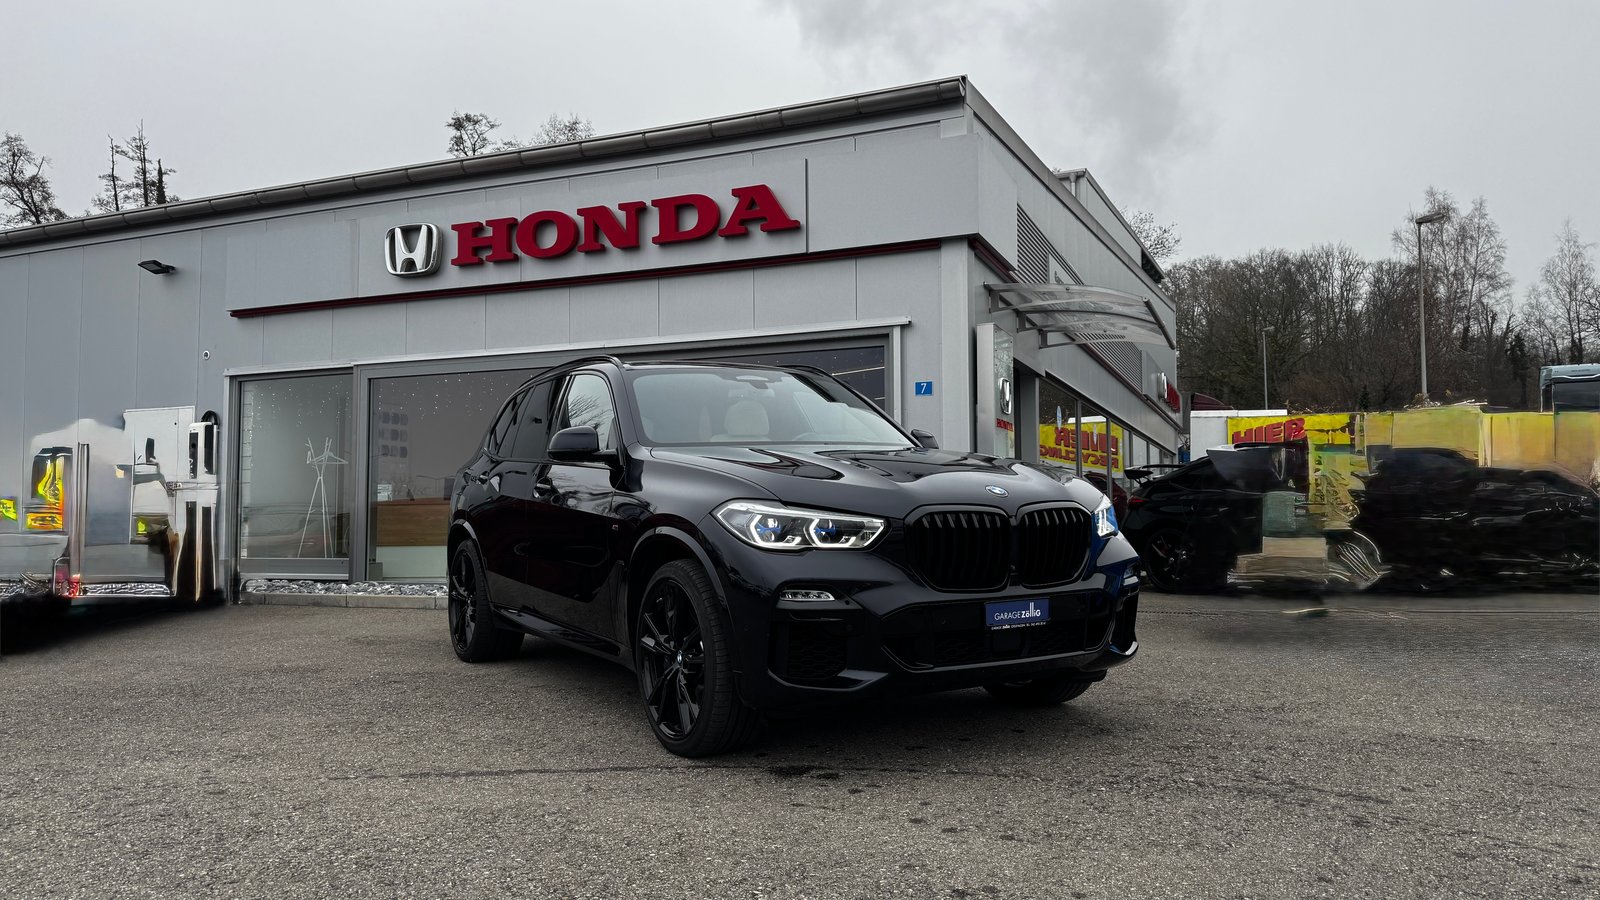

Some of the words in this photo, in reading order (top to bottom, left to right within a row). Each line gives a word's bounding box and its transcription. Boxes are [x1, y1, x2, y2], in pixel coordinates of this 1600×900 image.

[451, 184, 801, 267] HONDA
[920, 382, 927, 394] 7
[994, 611, 1021, 621] GARAGE
